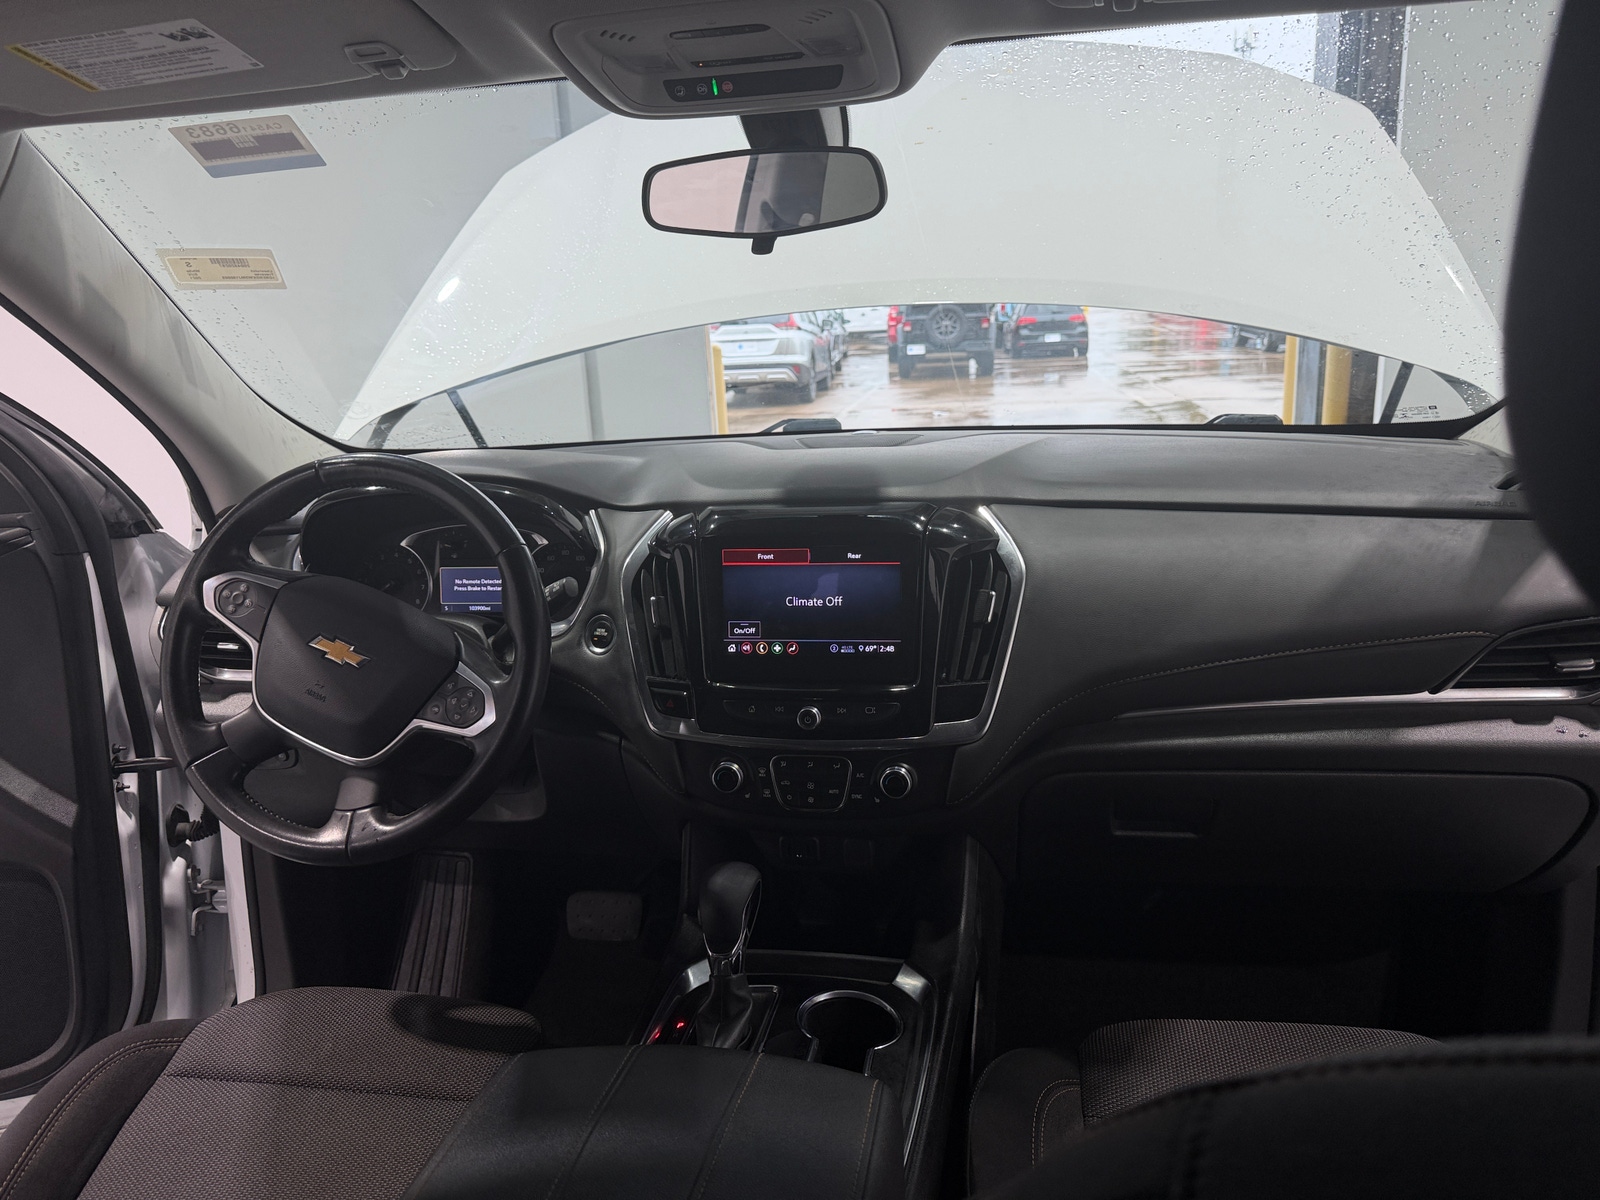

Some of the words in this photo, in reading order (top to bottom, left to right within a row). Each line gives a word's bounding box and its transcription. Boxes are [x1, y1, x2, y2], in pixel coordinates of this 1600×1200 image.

[785, 596, 824, 607] Climate
[825, 596, 843, 607] Off
[733, 627, 756, 635] On/Off
[879, 645, 895, 653] 2:48
